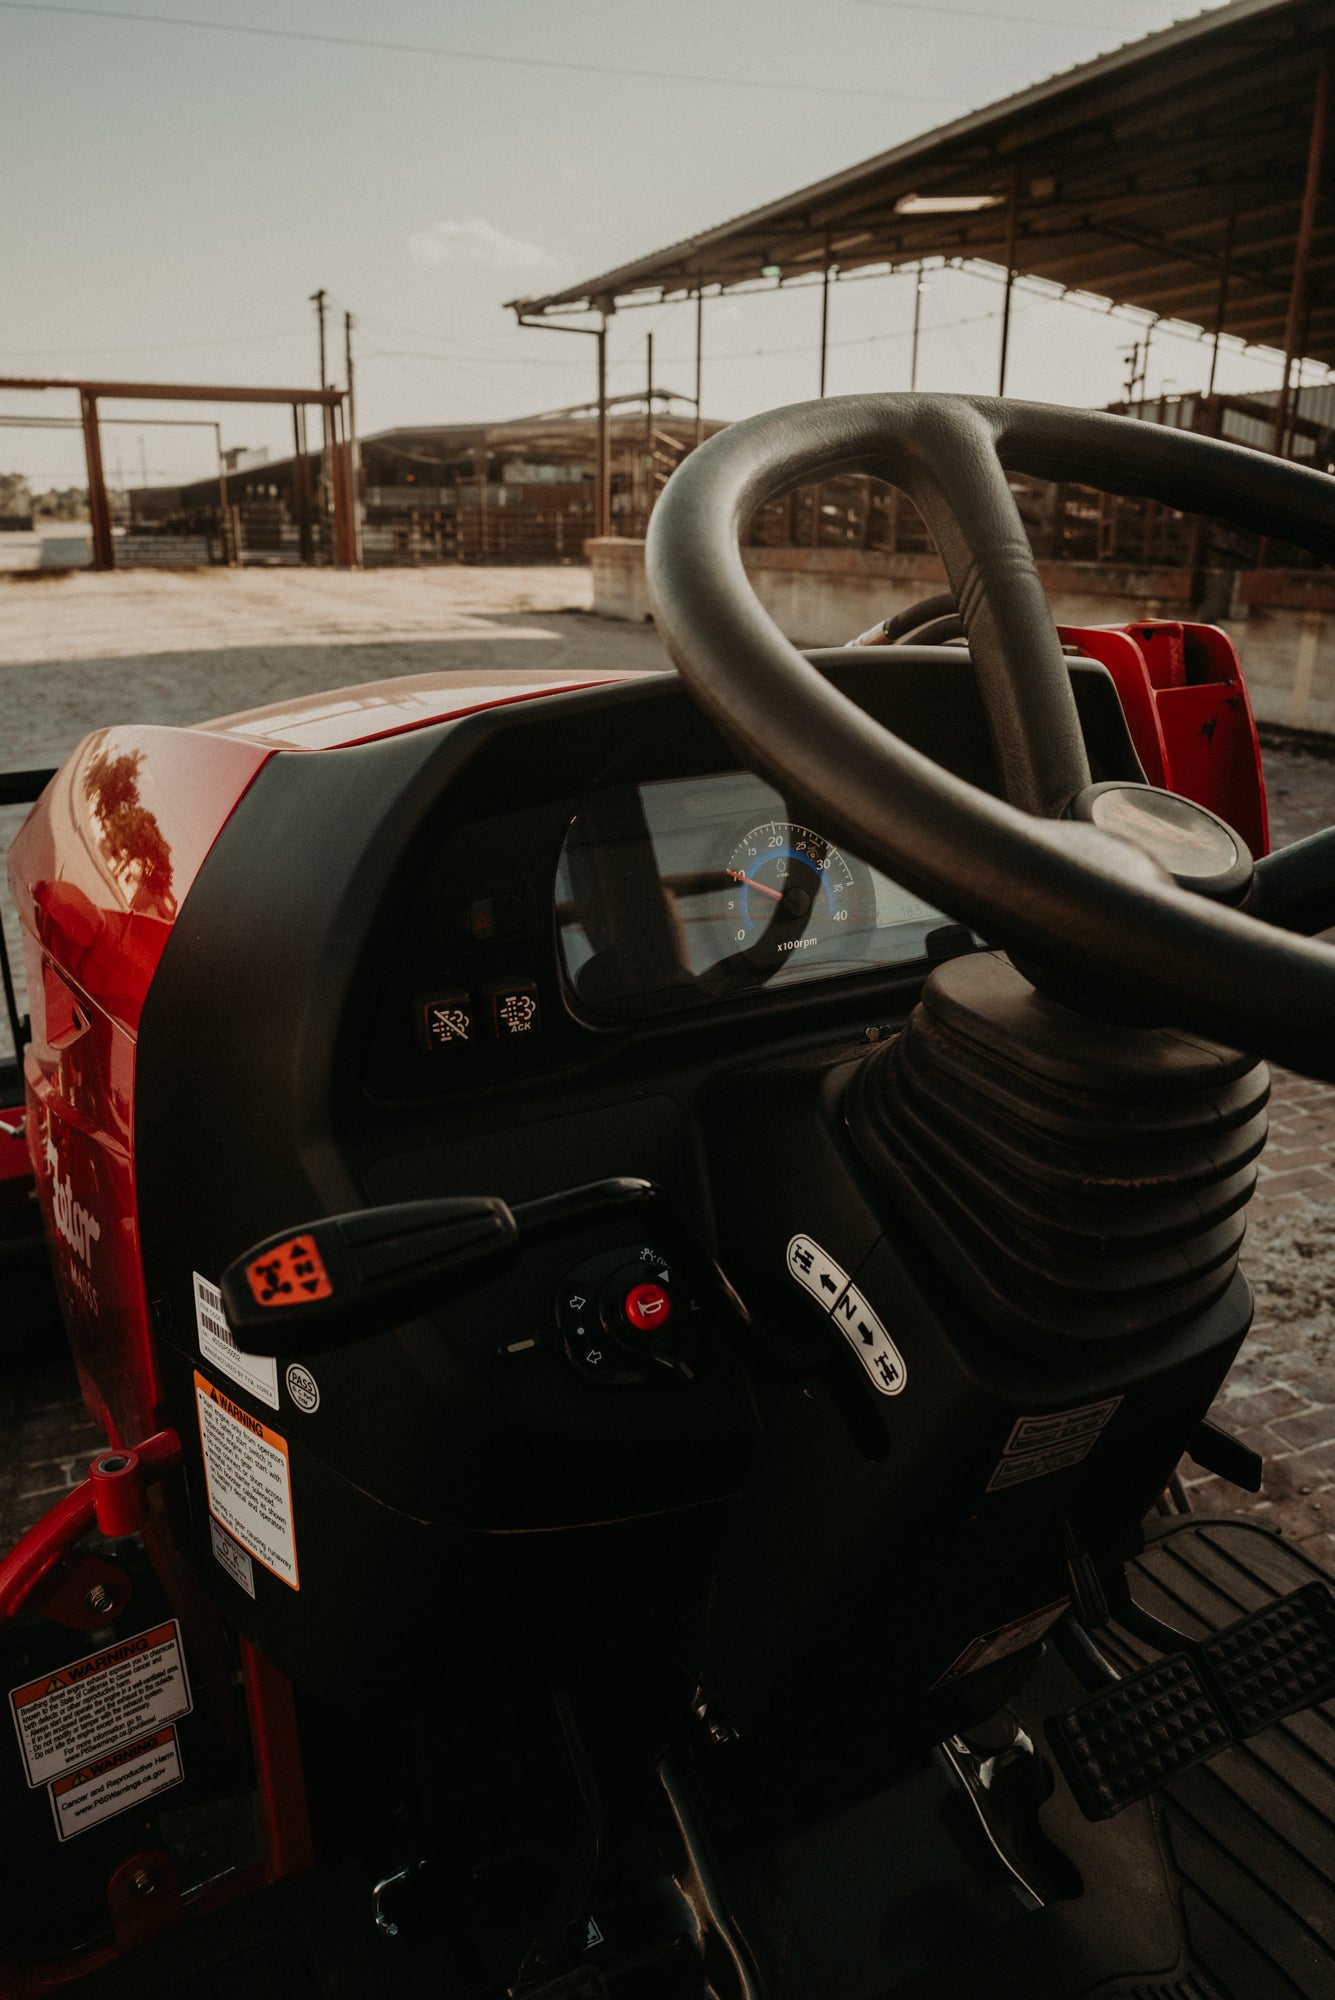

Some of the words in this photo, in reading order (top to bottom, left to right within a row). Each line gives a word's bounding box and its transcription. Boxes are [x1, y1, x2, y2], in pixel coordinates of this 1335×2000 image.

[747, 848, 757, 856] 15
[768, 836, 784, 848] 20
[796, 841, 806, 850] 25
[816, 858, 831, 870] 30
[733, 869, 745, 882] 10
[832, 884, 844, 893] 35
[728, 900, 735, 910] 5
[833, 910, 848, 922] 40
[776, 937, 817, 953] x100rpm
[510, 1021, 532, 1034] ACK
[838, 1296, 858, 1321] N
[204, 1346, 236, 1372] MANUFACTURED
[237, 1369, 242, 1378] BY
[256, 1383, 272, 1397] KOREA
[292, 1372, 312, 1391] PASS
[203, 1397, 213, 1410] Start
[214, 1408, 229, 1426] engine
[230, 1421, 241, 1436] only
[243, 1430, 255, 1446] from
[256, 1442, 284, 1468] operators
[219, 1395, 263, 1437] WARNING
[204, 1417, 224, 1439] bypassed
[225, 1437, 242, 1455] engine
[254, 1459, 267, 1473] start
[268, 1468, 281, 1484] with
[205, 1428, 233, 1454] transmission
[240, 1458, 253, 1474] gear.
[219, 1422, 234, 1439] safety
[235, 1435, 247, 1448] start
[248, 1444, 266, 1463] switch
[207, 1446, 225, 1465] terminal
[233, 1470, 250, 1487] starter
[251, 1483, 275, 1508] solenoid.
[209, 1455, 222, 1471] Attach
[223, 1469, 241, 1489] booster
[242, 1486, 258, 1503] cables
[267, 1506, 286, 1526] shown
[222, 1450, 241, 1470] connect
[249, 1473, 263, 1488] short
[264, 1485, 283, 1504] across
[216, 1471, 232, 1491] battery
[233, 1487, 246, 1502] decal
[258, 1509, 285, 1535] operators
[211, 1492, 228, 1515] Starting
[234, 1517, 245, 1531] gear
[246, 1527, 266, 1550] causing
[267, 1545, 291, 1570] runaway
[220, 1511, 232, 1526] result
[240, 1531, 257, 1550] serious
[20, 1699, 47, 1715] Breathing
[49, 1690, 65, 1702] diesel
[68, 1683, 85, 1694] engine
[86, 1672, 107, 1685] exhaust
[108, 1663, 130, 1676] exposes
[149, 1642, 174, 1656] chemicals
[67, 1639, 148, 1680] WARNING
[22, 1711, 40, 1722] known
[59, 1694, 74, 1706] State
[82, 1680, 108, 1695] California
[116, 1669, 132, 1681] cause
[133, 1661, 150, 1673] cancer
[23, 1720, 36, 1731] birth
[37, 1711, 58, 1723] defects
[66, 1700, 80, 1711] other
[116, 1677, 131, 1688] harm.
[30, 1724, 48, 1736] Always
[49, 1717, 61, 1727] start
[73, 1704, 93, 1716] operate
[103, 1691, 120, 1703] engine
[167, 1664, 178, 1673] area.
[52, 1719, 77, 1733] enclosed
[78, 1712, 92, 1723] area,
[93, 1705, 105, 1715] vent
[116, 1691, 137, 1703] exhaust
[154, 1674, 174, 1686] outside.
[53, 1729, 71, 1742] modify
[80, 1717, 99, 1730] tamper
[100, 1710, 111, 1720] with
[122, 1697, 143, 1709] exhaust
[144, 1687, 163, 1699] system.
[55, 1740, 65, 1749] idle
[76, 1728, 94, 1739] engine
[96, 1719, 113, 1730] except
[123, 1703, 149, 1718] necessary
[76, 1738, 91, 1750] more
[92, 1722, 124, 1741] information
[92, 1738, 157, 1773] WARNING
[61, 1792, 88, 1810] Cancer
[90, 1784, 104, 1796] and
[106, 1762, 152, 1788] Reproductive
[154, 1751, 173, 1763] Harm
[74, 1768, 165, 1817] www.P65Warnings.ca.gov
